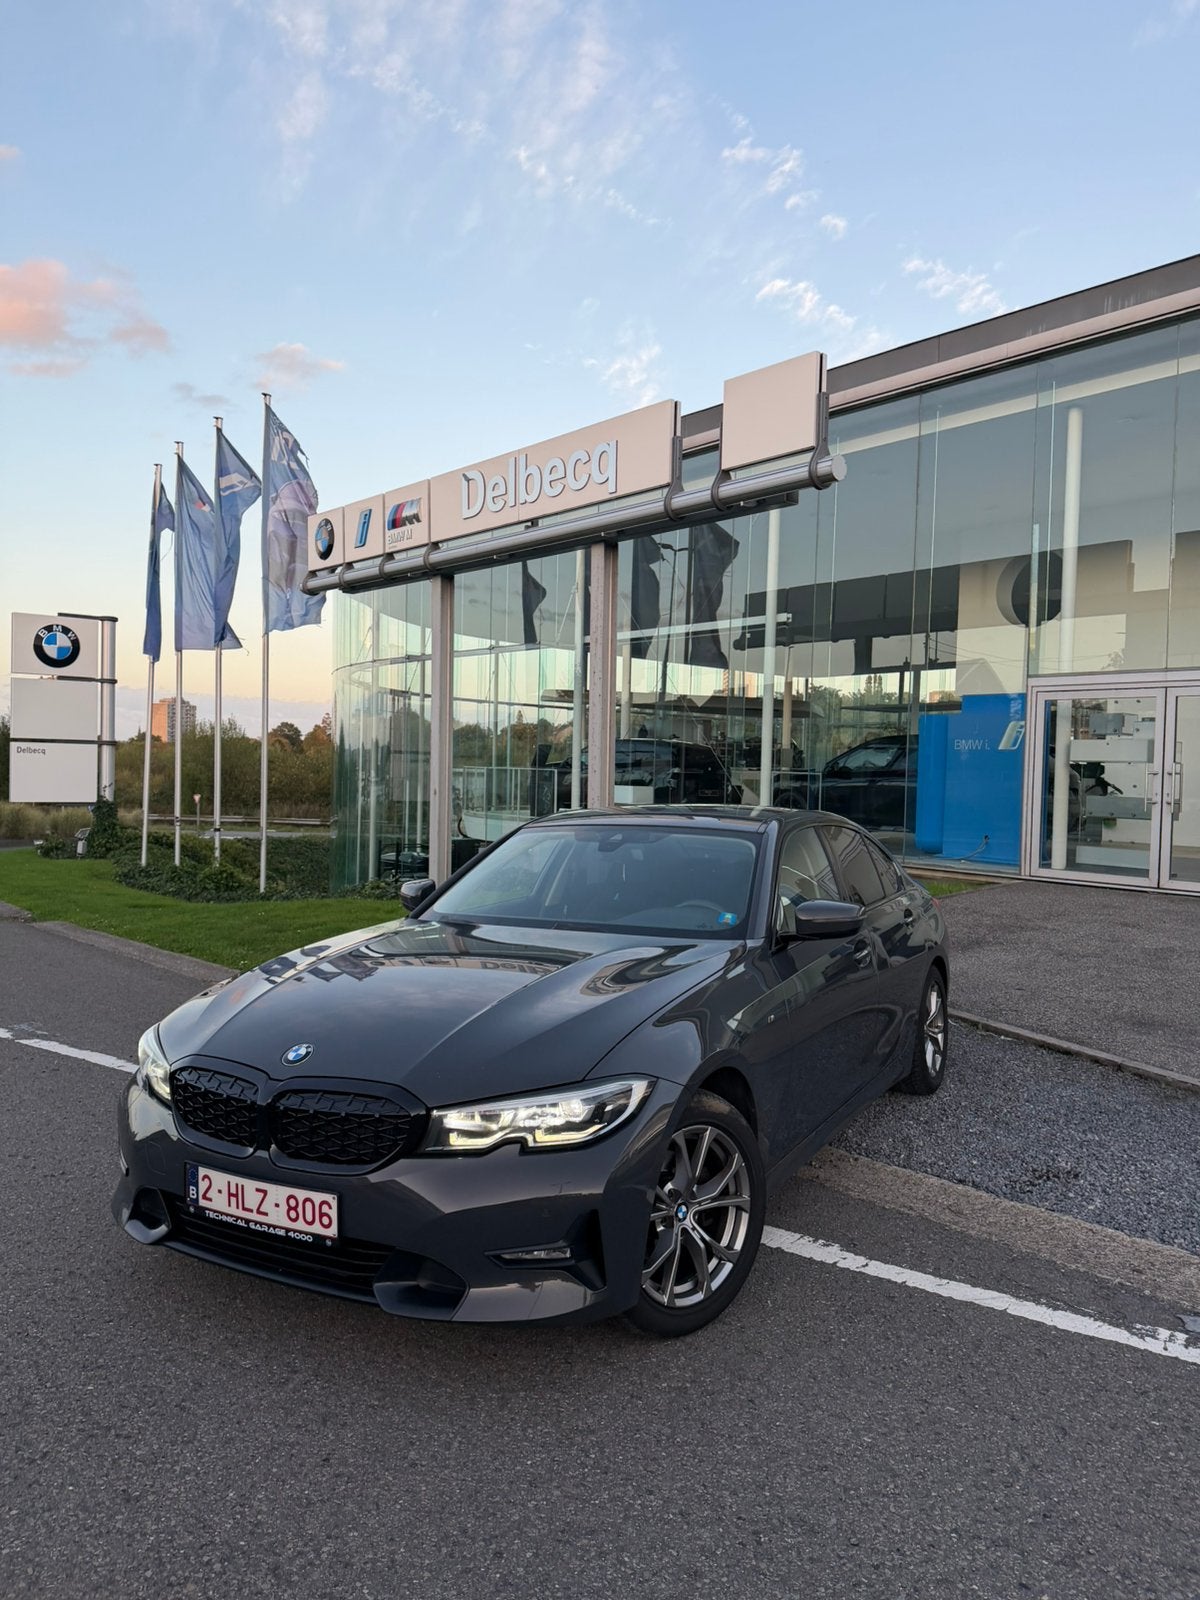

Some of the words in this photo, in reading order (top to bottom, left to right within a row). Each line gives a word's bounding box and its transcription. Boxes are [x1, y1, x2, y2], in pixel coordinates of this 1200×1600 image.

[462, 440, 618, 519] Delbecq
[38, 625, 77, 641] BMW
[16, 745, 46, 756] Delbecq
[954, 739, 983, 750] BMW
[189, 1186, 197, 1199] B
[201, 1174, 333, 1230] 2-HLZ-806
[204, 1210, 248, 1227] TECHNICAL
[249, 1221, 287, 1237] GARAGE
[288, 1230, 313, 1243] 4000
